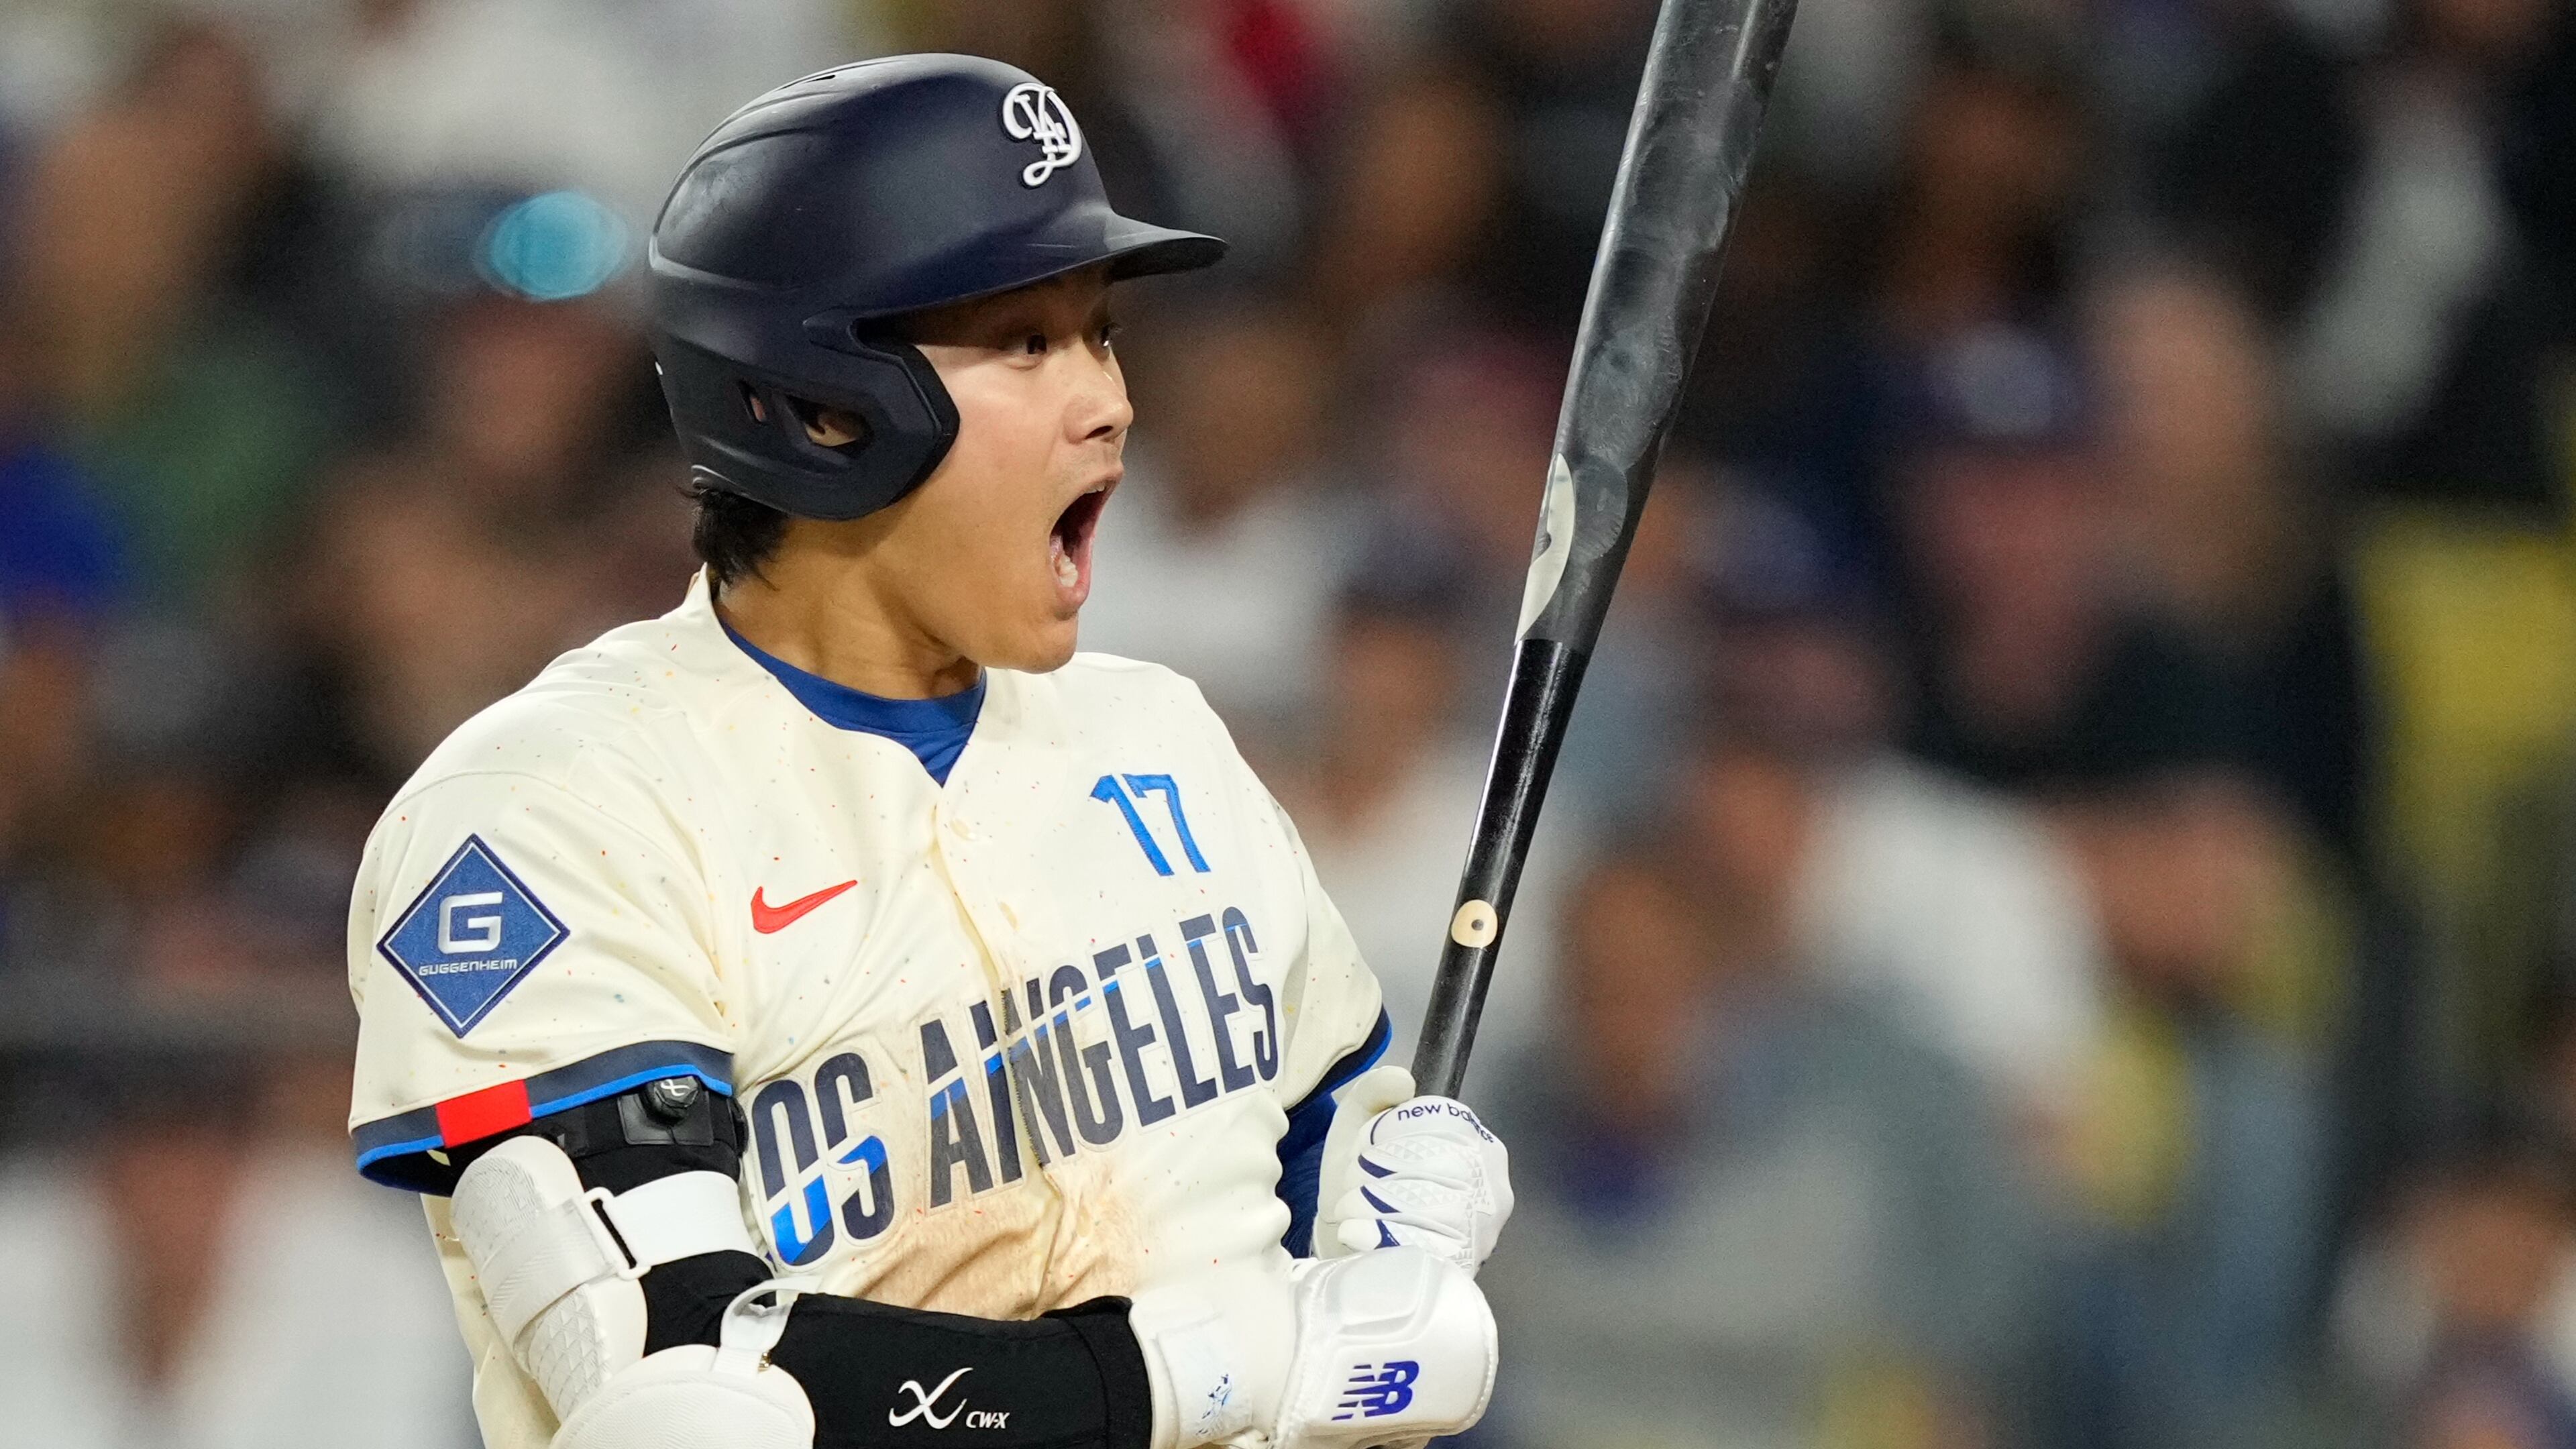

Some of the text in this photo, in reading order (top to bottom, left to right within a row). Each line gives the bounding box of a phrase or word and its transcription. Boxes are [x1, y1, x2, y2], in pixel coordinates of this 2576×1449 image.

[1090, 773, 1211, 877] 17
[437, 891, 504, 955] G
[418, 959, 517, 977] GUGGENHEIM
[751, 906, 1279, 1267] OS ANGELES
[1397, 1104, 1442, 1121] new
[965, 1410, 1010, 1430] CW-X
